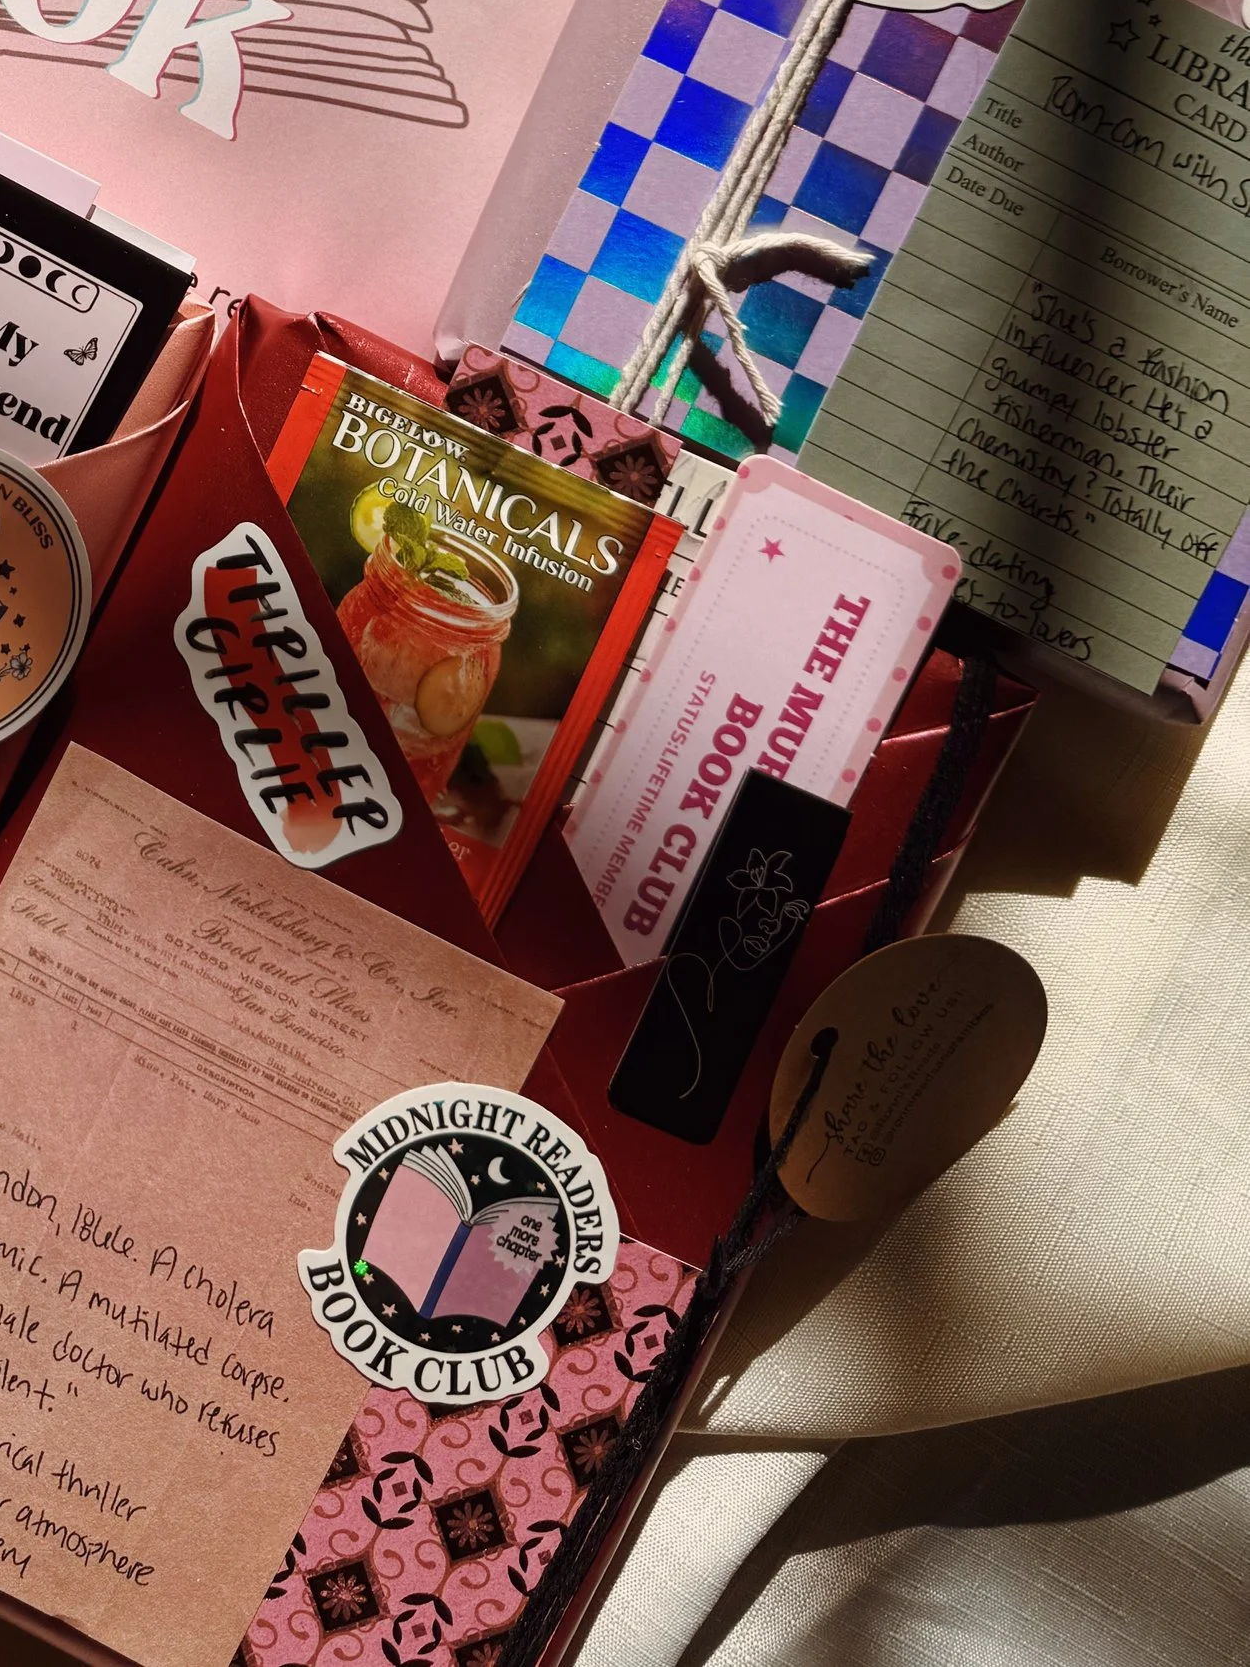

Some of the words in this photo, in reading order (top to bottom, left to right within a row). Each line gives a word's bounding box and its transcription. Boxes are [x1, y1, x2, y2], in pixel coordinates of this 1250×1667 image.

[962, 133, 1025, 172] Author
[983, 97, 1023, 130] Title
[946, 166, 987, 199] Date
[990, 188, 1025, 217] Due
[1099, 246, 1189, 303] Borrower's
[1192, 292, 1239, 329] Name
[12, 496, 54, 550] BLISS
[330, 411, 625, 577] BOTANICALS
[376, 477, 429, 514] Cold
[434, 503, 502, 548] Water
[502, 538, 594, 594] Infusion
[802, 592, 872, 684] THE
[185, 617, 317, 815] GIRLIE
[217, 535, 389, 838] THRILLER
[678, 693, 764, 820] BOOK
[622, 823, 697, 938] CLUB
[238, 971, 300, 1009] MISSION
[309, 1007, 370, 1042] STREET
[258, 961, 308, 987] and
[309, 977, 372, 1024] Shoes
[344, 1099, 526, 1174] MIDNIGHT
[522, 1122, 604, 1277] READERS
[520, 1214, 543, 1233] one
[497, 1232, 542, 1263] chapter
[510, 1224, 539, 1248] more
[58, 1270, 85, 1304] A
[88, 1292, 210, 1366] mutilated
[307, 1257, 410, 1382] BOOK
[414, 1345, 536, 1396] CLUB
